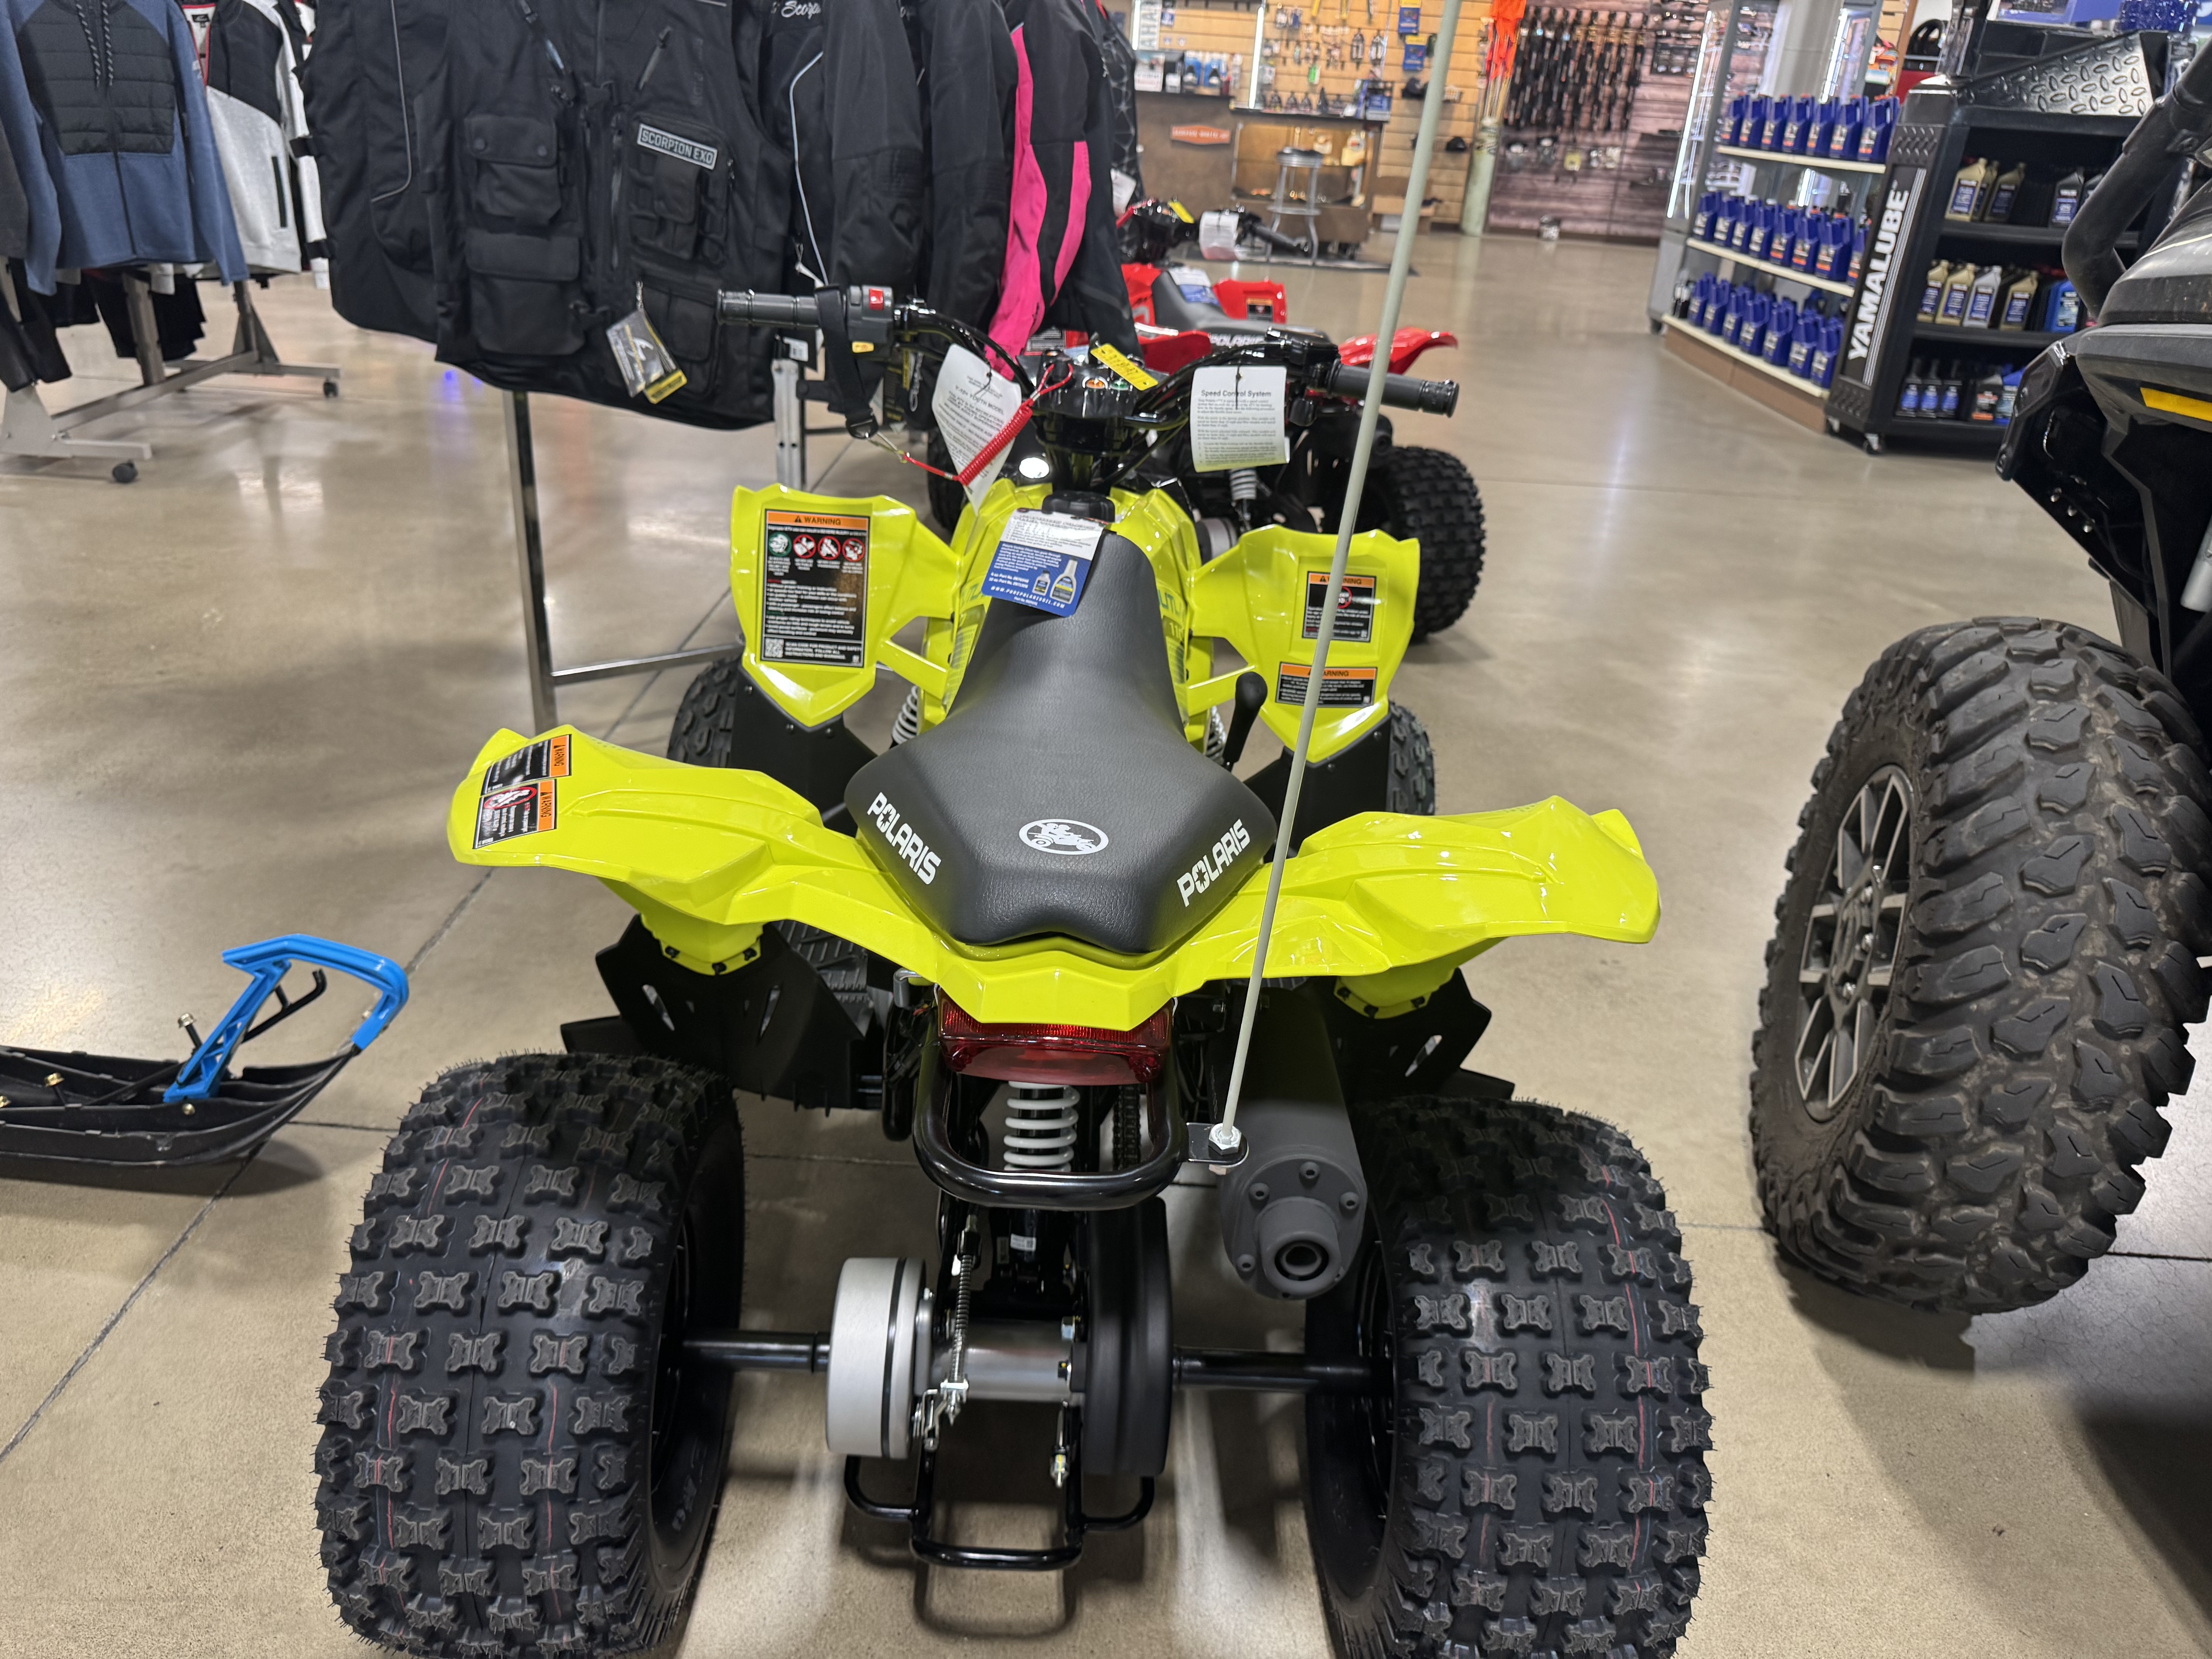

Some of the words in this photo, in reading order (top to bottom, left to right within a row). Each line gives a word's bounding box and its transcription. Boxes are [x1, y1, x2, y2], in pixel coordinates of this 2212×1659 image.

[641, 130, 692, 158] SCORPION
[693, 147, 713, 164] EXO
[1848, 190, 1909, 360] YAMALUBE
[804, 517, 842, 526] WARNING
[541, 795, 552, 818] WARNING
[867, 792, 942, 884] POLARIS
[1177, 819, 1250, 907] POLARIS
